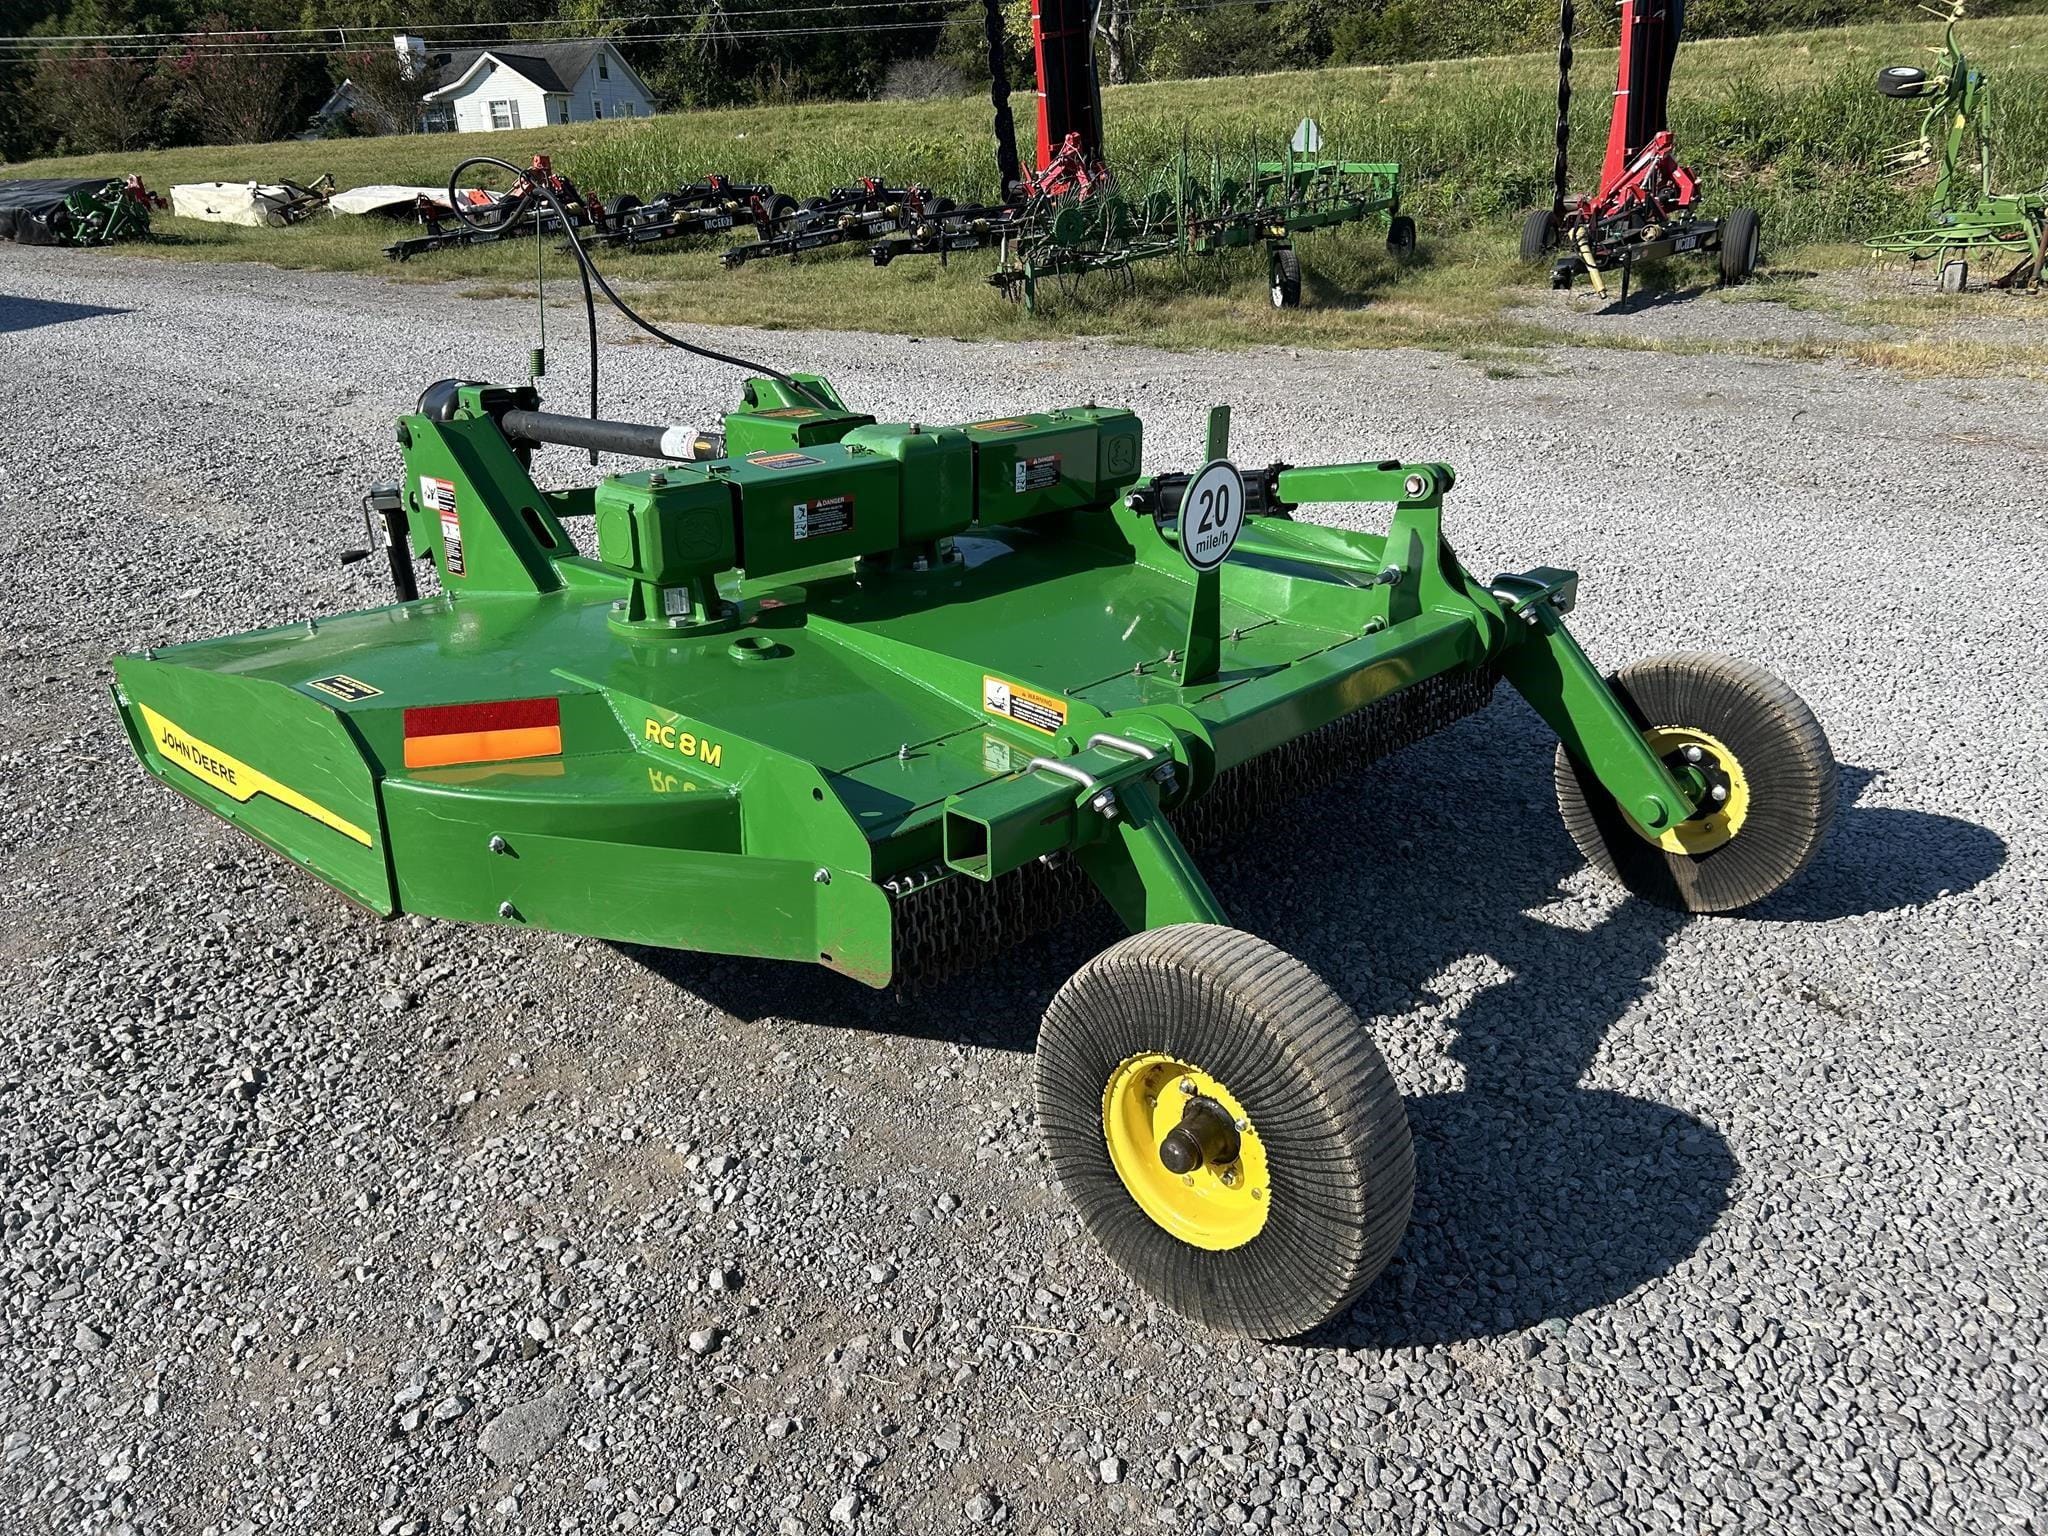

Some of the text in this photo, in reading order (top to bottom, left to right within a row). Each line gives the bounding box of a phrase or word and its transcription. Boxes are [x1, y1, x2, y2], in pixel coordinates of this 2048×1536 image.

[704, 216, 733, 230] MC107
[868, 220, 896, 235] MC107
[822, 496, 845, 506] DANGER
[1197, 484, 1230, 535] 20
[1195, 530, 1229, 554] mile/h
[1027, 692, 1053, 707] WARNING
[161, 727, 237, 786] JOHN DEERE
